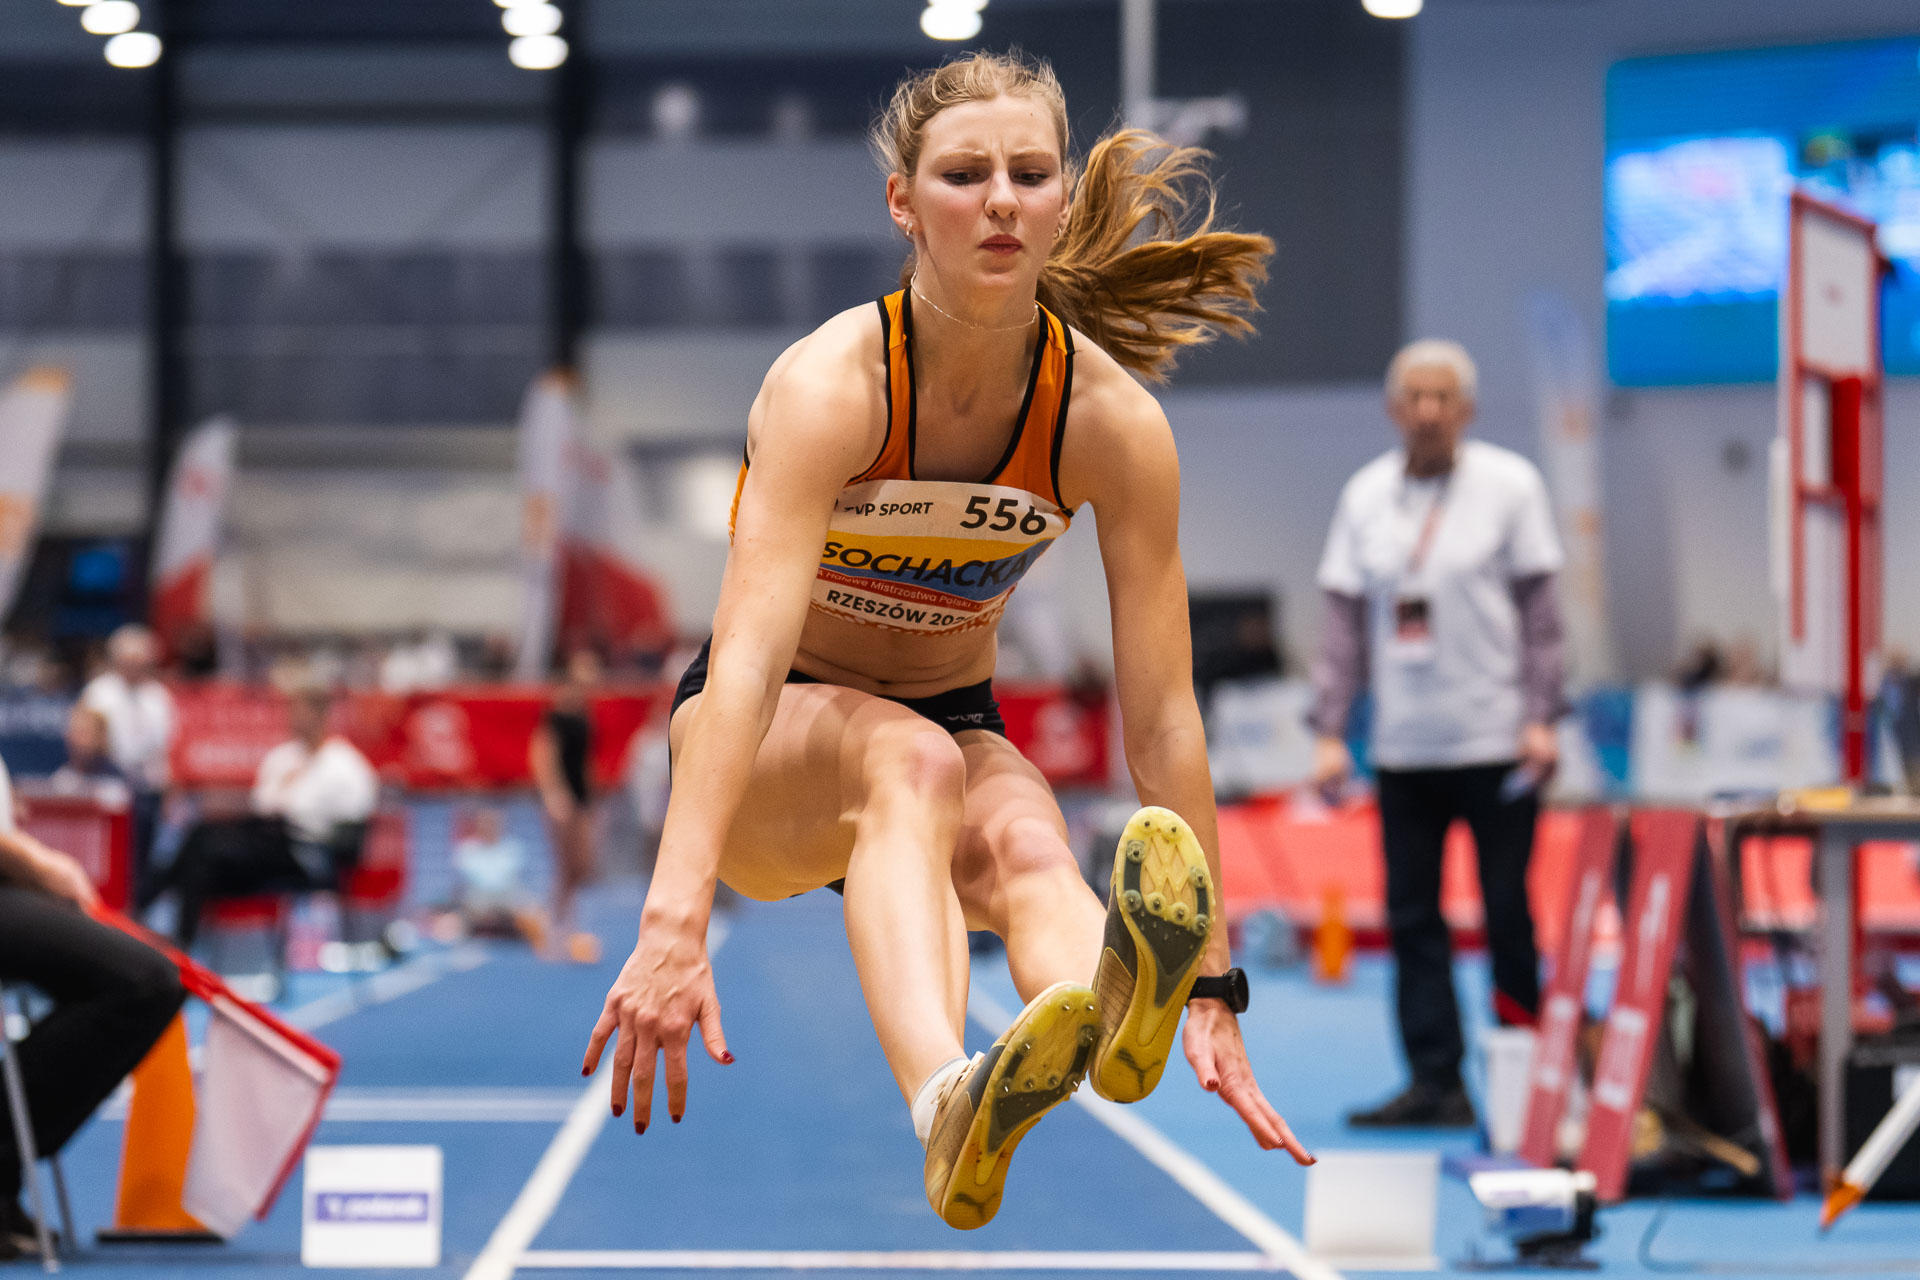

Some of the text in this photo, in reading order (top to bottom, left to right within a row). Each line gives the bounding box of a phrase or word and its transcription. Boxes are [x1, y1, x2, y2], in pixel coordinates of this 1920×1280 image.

[879, 502, 933, 516] SPORT
[960, 496, 1047, 535] 556
[823, 541, 1028, 587] SOCHACKA
[827, 590, 927, 623] RZESZÓW
[871, 581, 937, 602] Mistrzostwa
[939, 595, 971, 607] Polski
